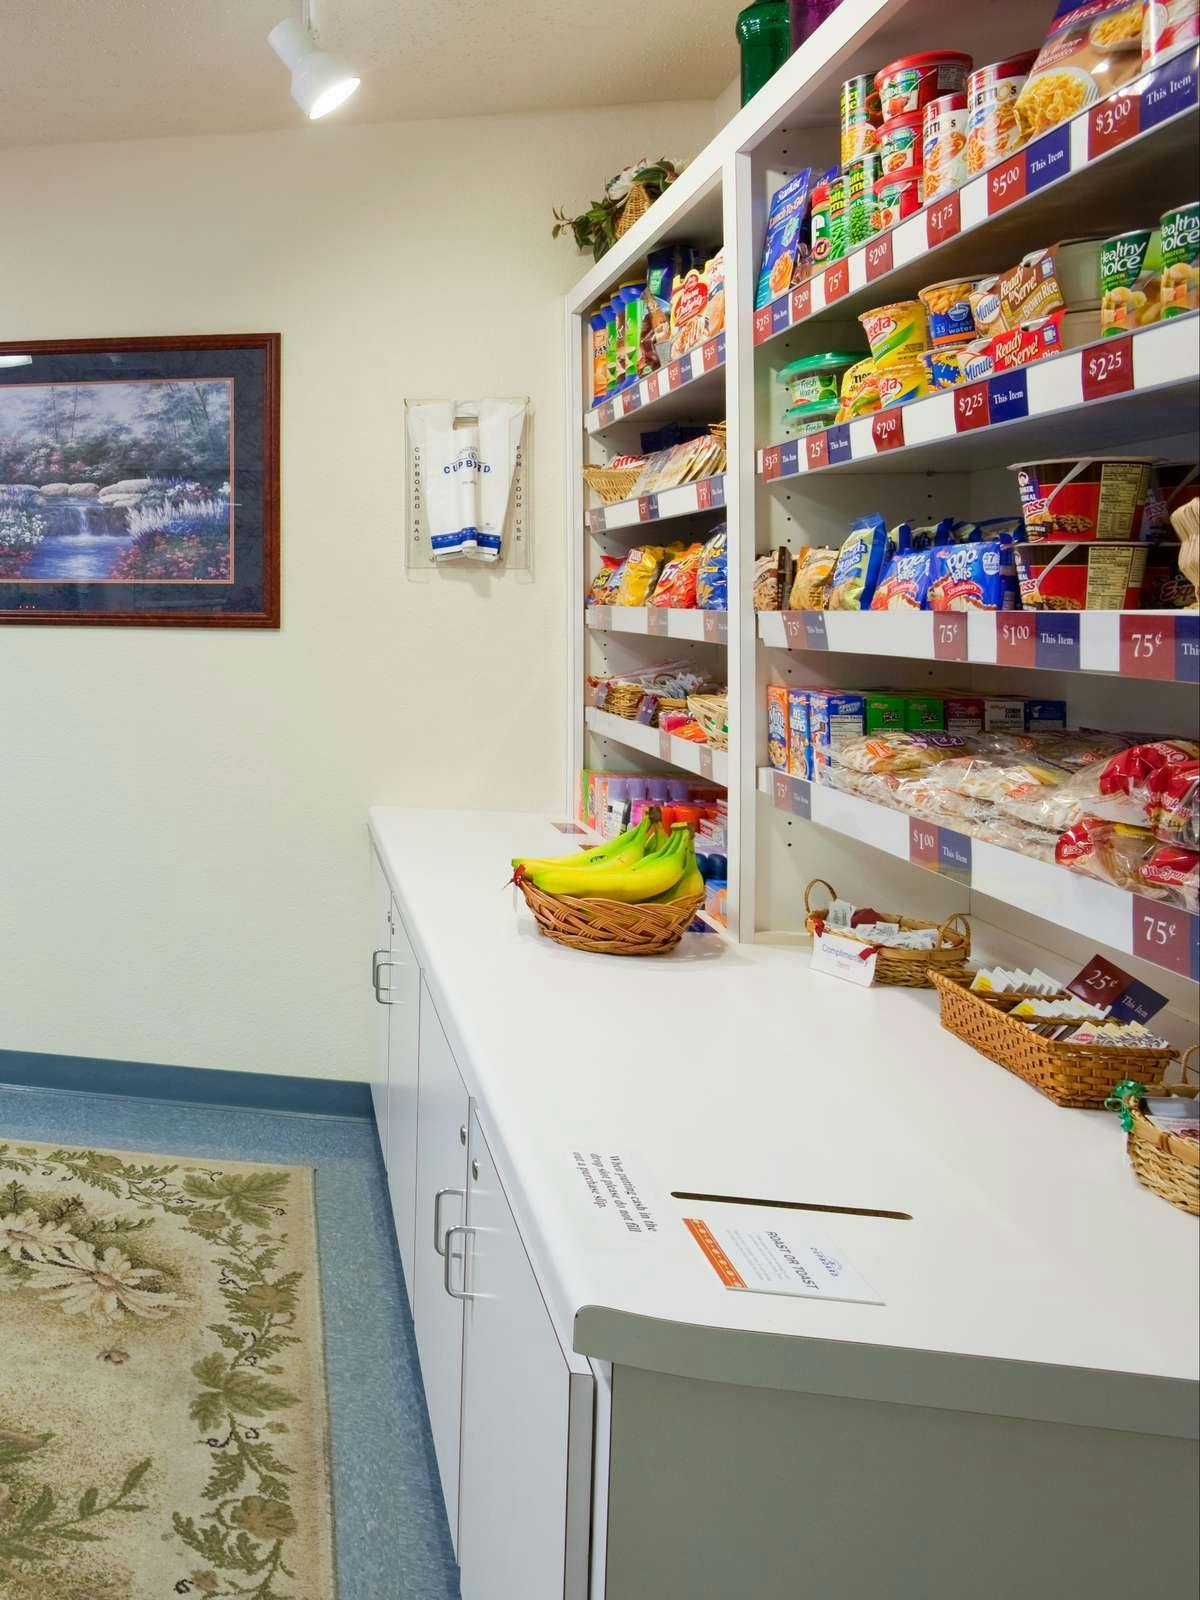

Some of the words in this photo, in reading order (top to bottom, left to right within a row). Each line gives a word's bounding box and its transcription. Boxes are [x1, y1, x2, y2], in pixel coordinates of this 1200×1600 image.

[1147, 88, 1167, 106] This
[1169, 73, 1192, 94] Item
[1030, 159, 1047, 174] This
[1047, 149, 1064, 166] Item
[1000, 265, 1025, 299] Ready
[1014, 269, 1038, 305] Serve!
[975, 296, 1000, 321] Minute
[1022, 289, 1044, 320] Brown
[1040, 281, 1058, 301] Rice
[948, 326, 973, 335] water
[995, 330, 1022, 363] Ready
[1010, 336, 1039, 368] Serve!
[963, 354, 994, 382] Minute
[992, 393, 1008, 405] This
[1008, 389, 1024, 400] Item
[939, 625, 958, 644] 75¢
[1040, 633, 1058, 645] This
[1057, 634, 1074, 646] Item
[1131, 632, 1163, 657] 75¢
[942, 846, 955, 858] This
[955, 852, 967, 864] Item
[1143, 915, 1176, 945] 75¢
[1084, 969, 1119, 990] 25¢
[609, 1155, 624, 1173] When
[630, 1196, 649, 1211] cash
[643, 1220, 658, 1233] the
[766, 1230, 792, 1255] ROAST
[783, 1252, 801, 1266] OR
[792, 1264, 820, 1290] TOAST
